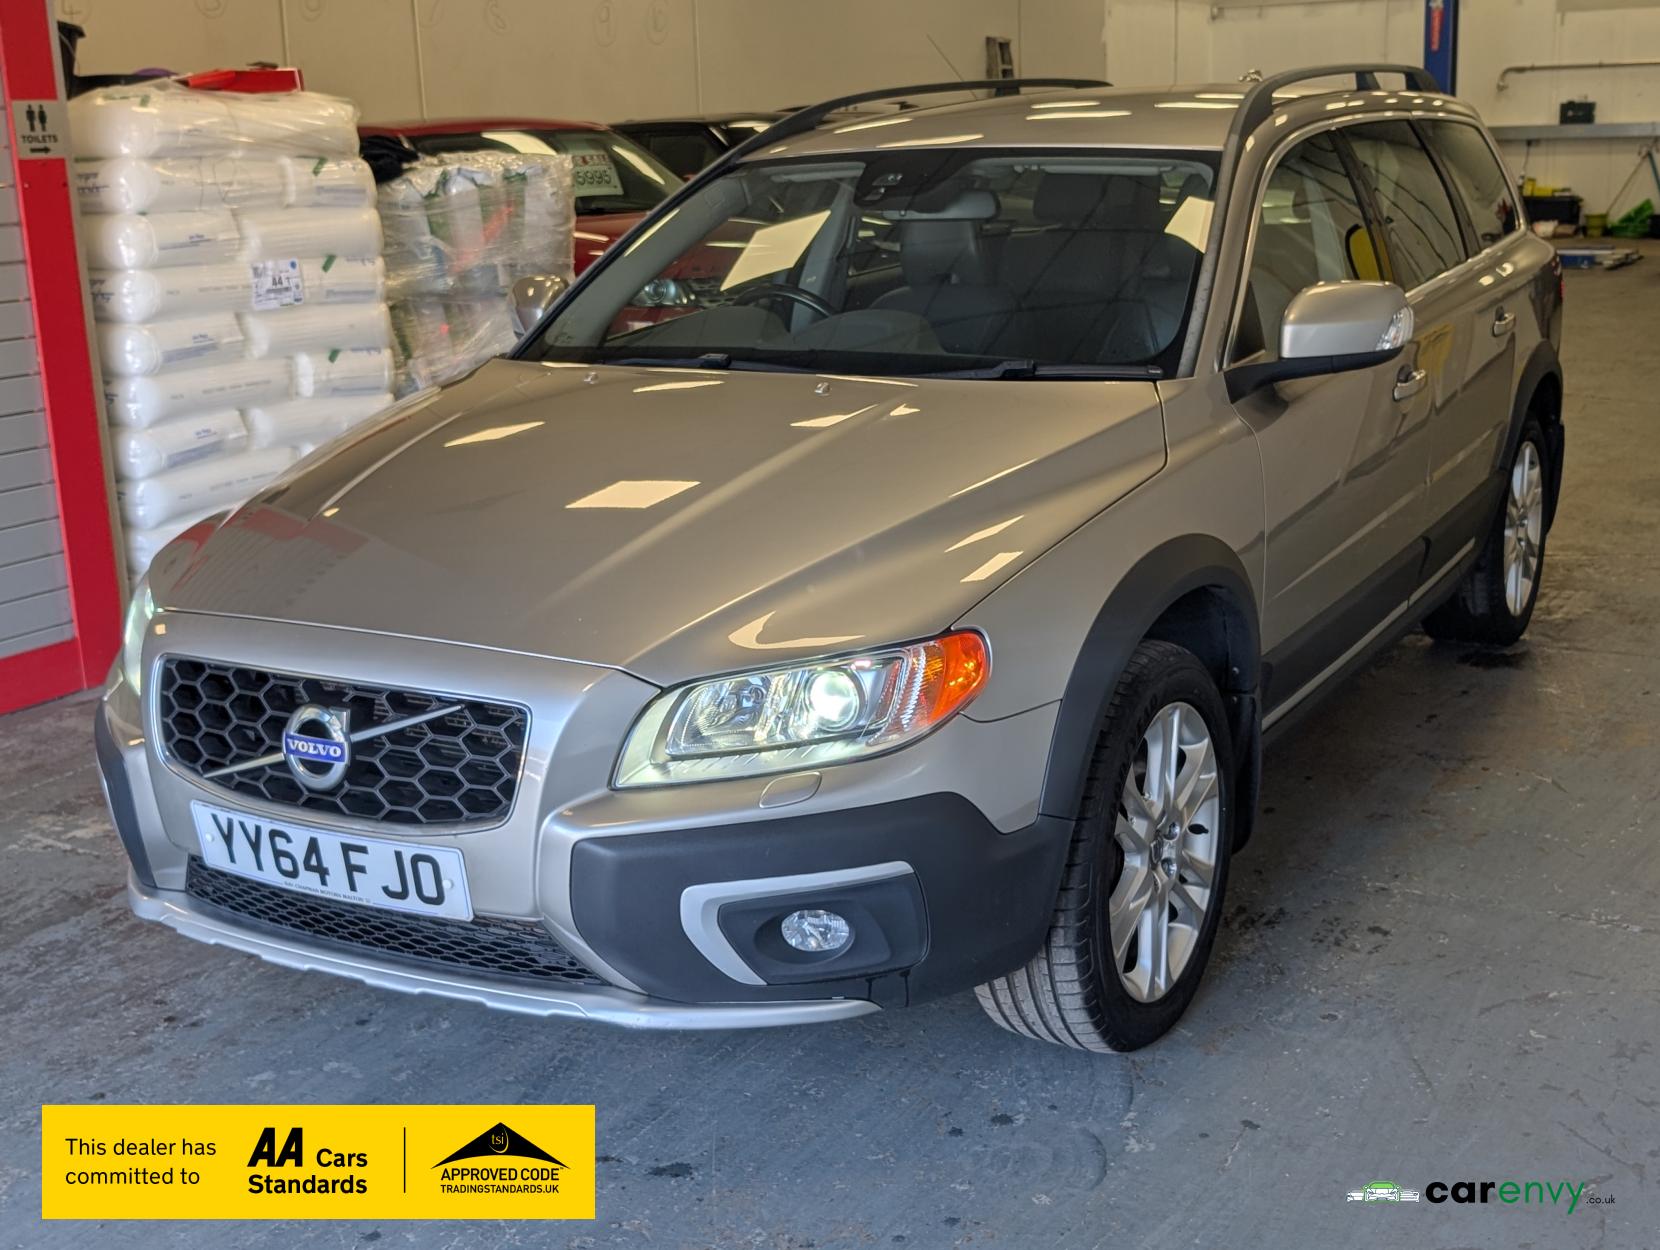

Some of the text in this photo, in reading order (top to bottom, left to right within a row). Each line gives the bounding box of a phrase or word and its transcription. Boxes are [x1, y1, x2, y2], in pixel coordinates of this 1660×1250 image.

[21, 134, 58, 144] TOILETS
[287, 738, 342, 758] VOLVO
[210, 813, 446, 906] YY64 FJO
